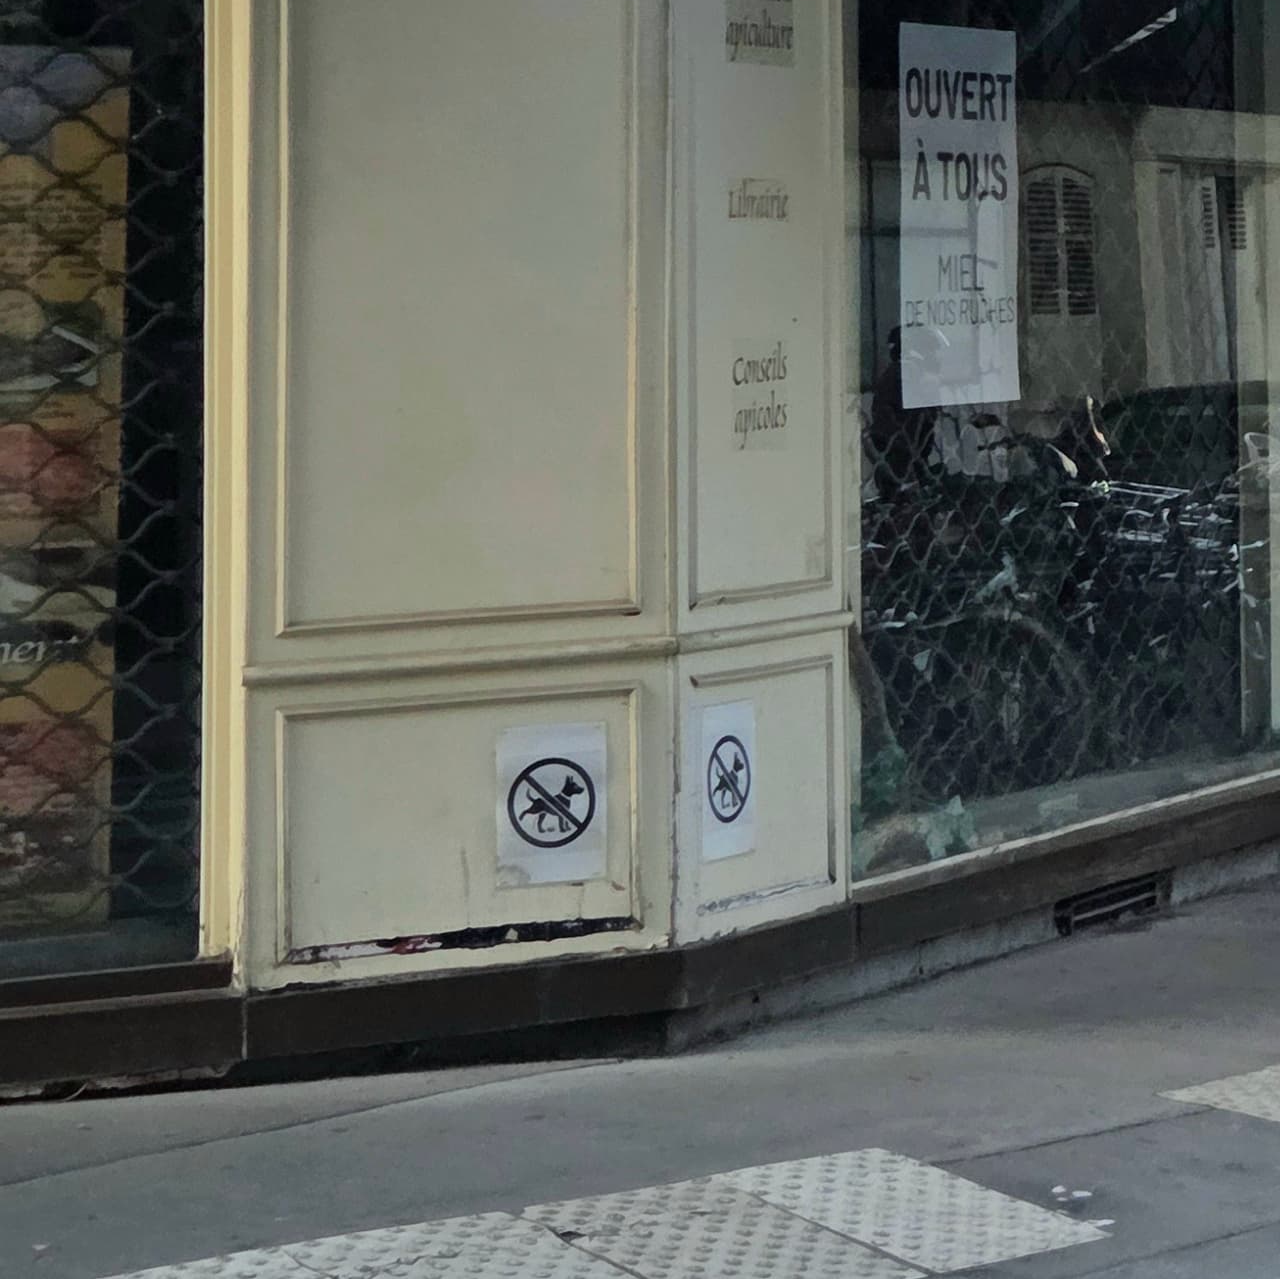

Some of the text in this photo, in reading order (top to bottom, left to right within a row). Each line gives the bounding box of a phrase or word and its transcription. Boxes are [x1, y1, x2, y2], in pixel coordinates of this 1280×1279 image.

[905, 67, 1012, 121] OUVERT
[912, 137, 1008, 201] À TOUS
[938, 254, 984, 292] MIEL
[904, 300, 925, 327] DE
[927, 299, 957, 326] NOS
[732, 341, 787, 386] Conseils
[734, 390, 787, 450] apicoles
